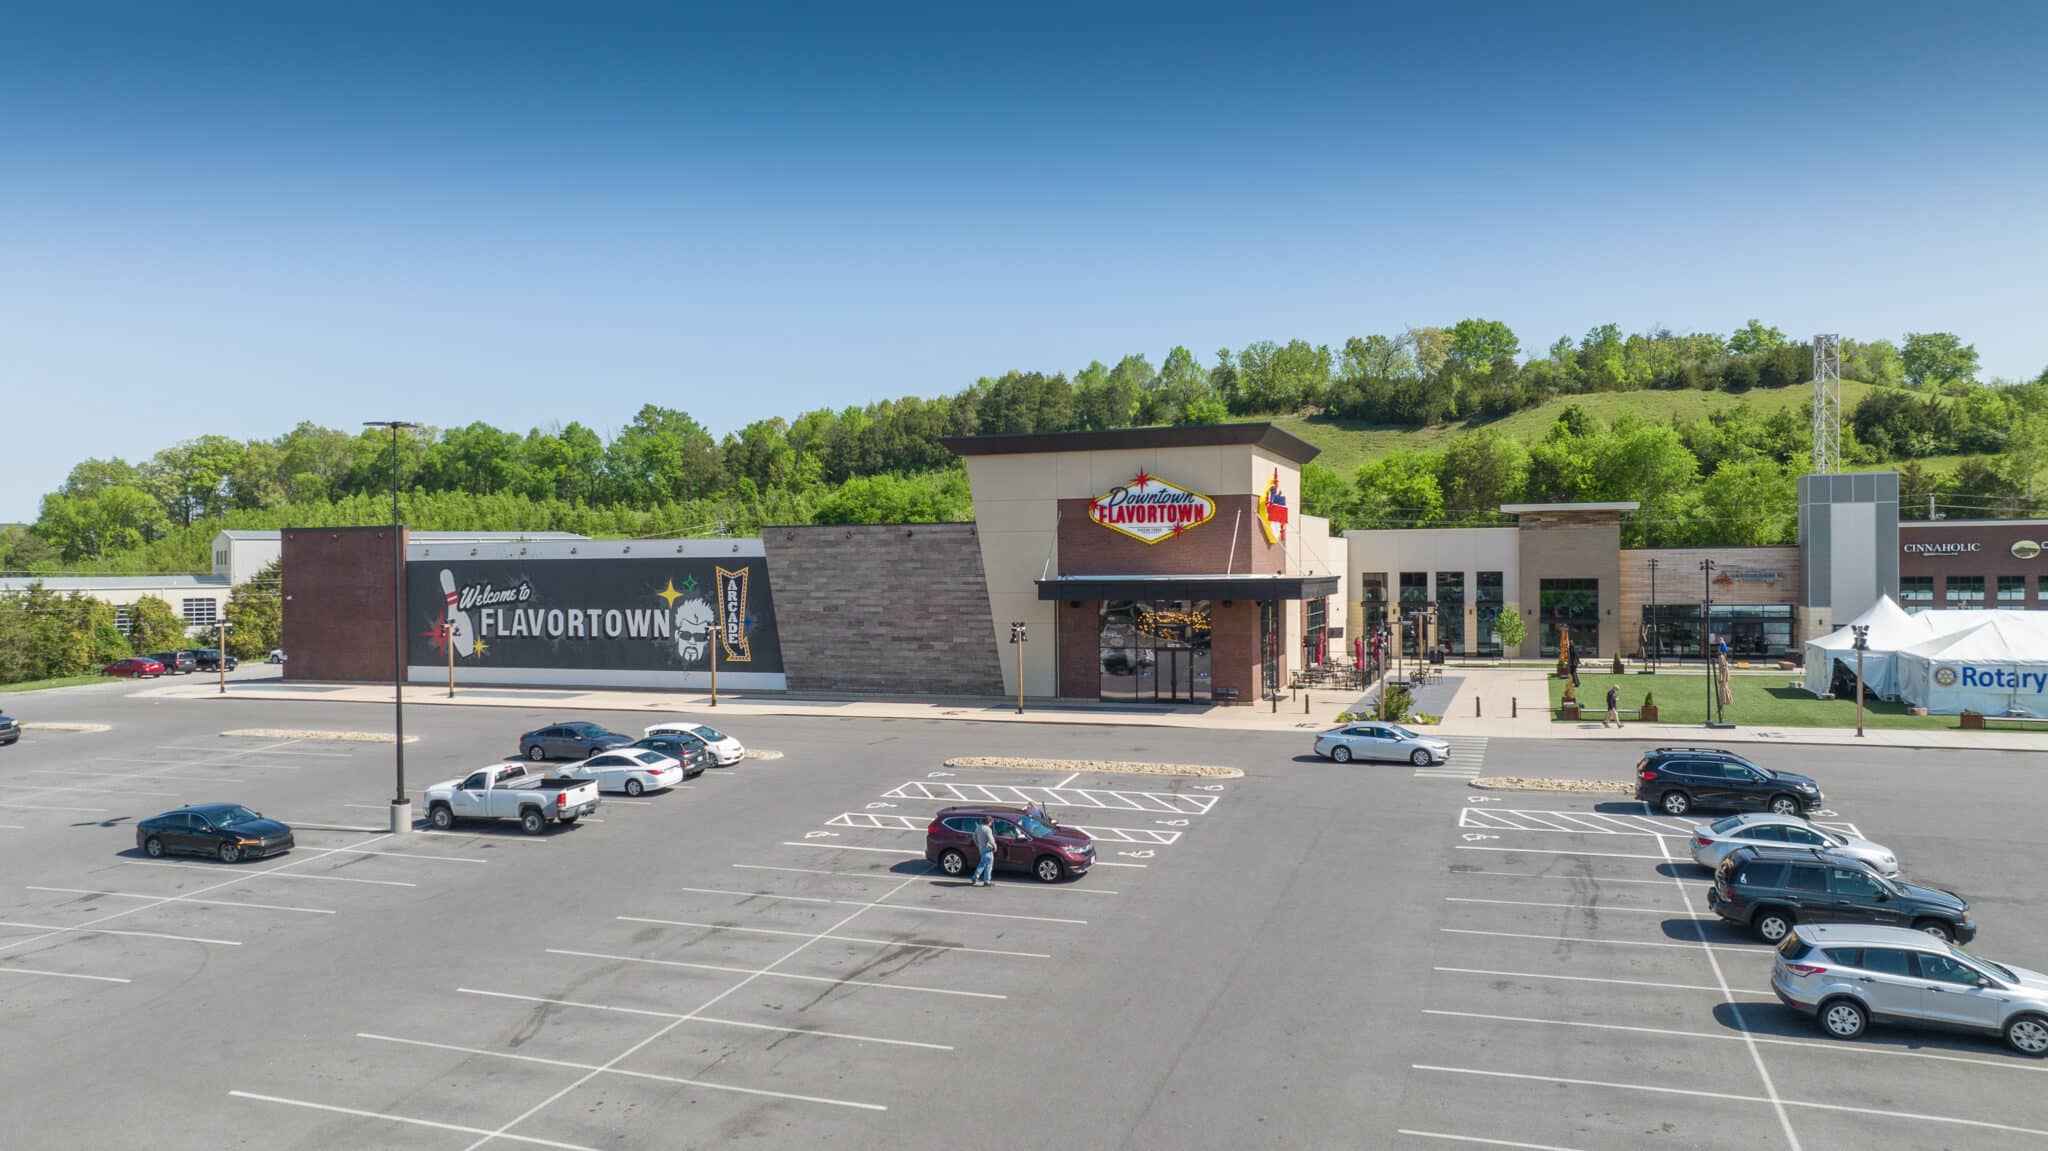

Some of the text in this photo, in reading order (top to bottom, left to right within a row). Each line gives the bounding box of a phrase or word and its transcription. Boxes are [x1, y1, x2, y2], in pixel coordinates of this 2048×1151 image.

[1110, 487, 1195, 506] Downtown
[1099, 504, 1204, 524] FLAVORTOWN
[1904, 543, 1980, 553] CINNAHOLIC
[459, 583, 531, 609] Welcome to
[480, 608, 670, 638] FLAVORTOWN
[727, 579, 739, 644] ARCADE
[1962, 666, 2048, 693] Rotary
